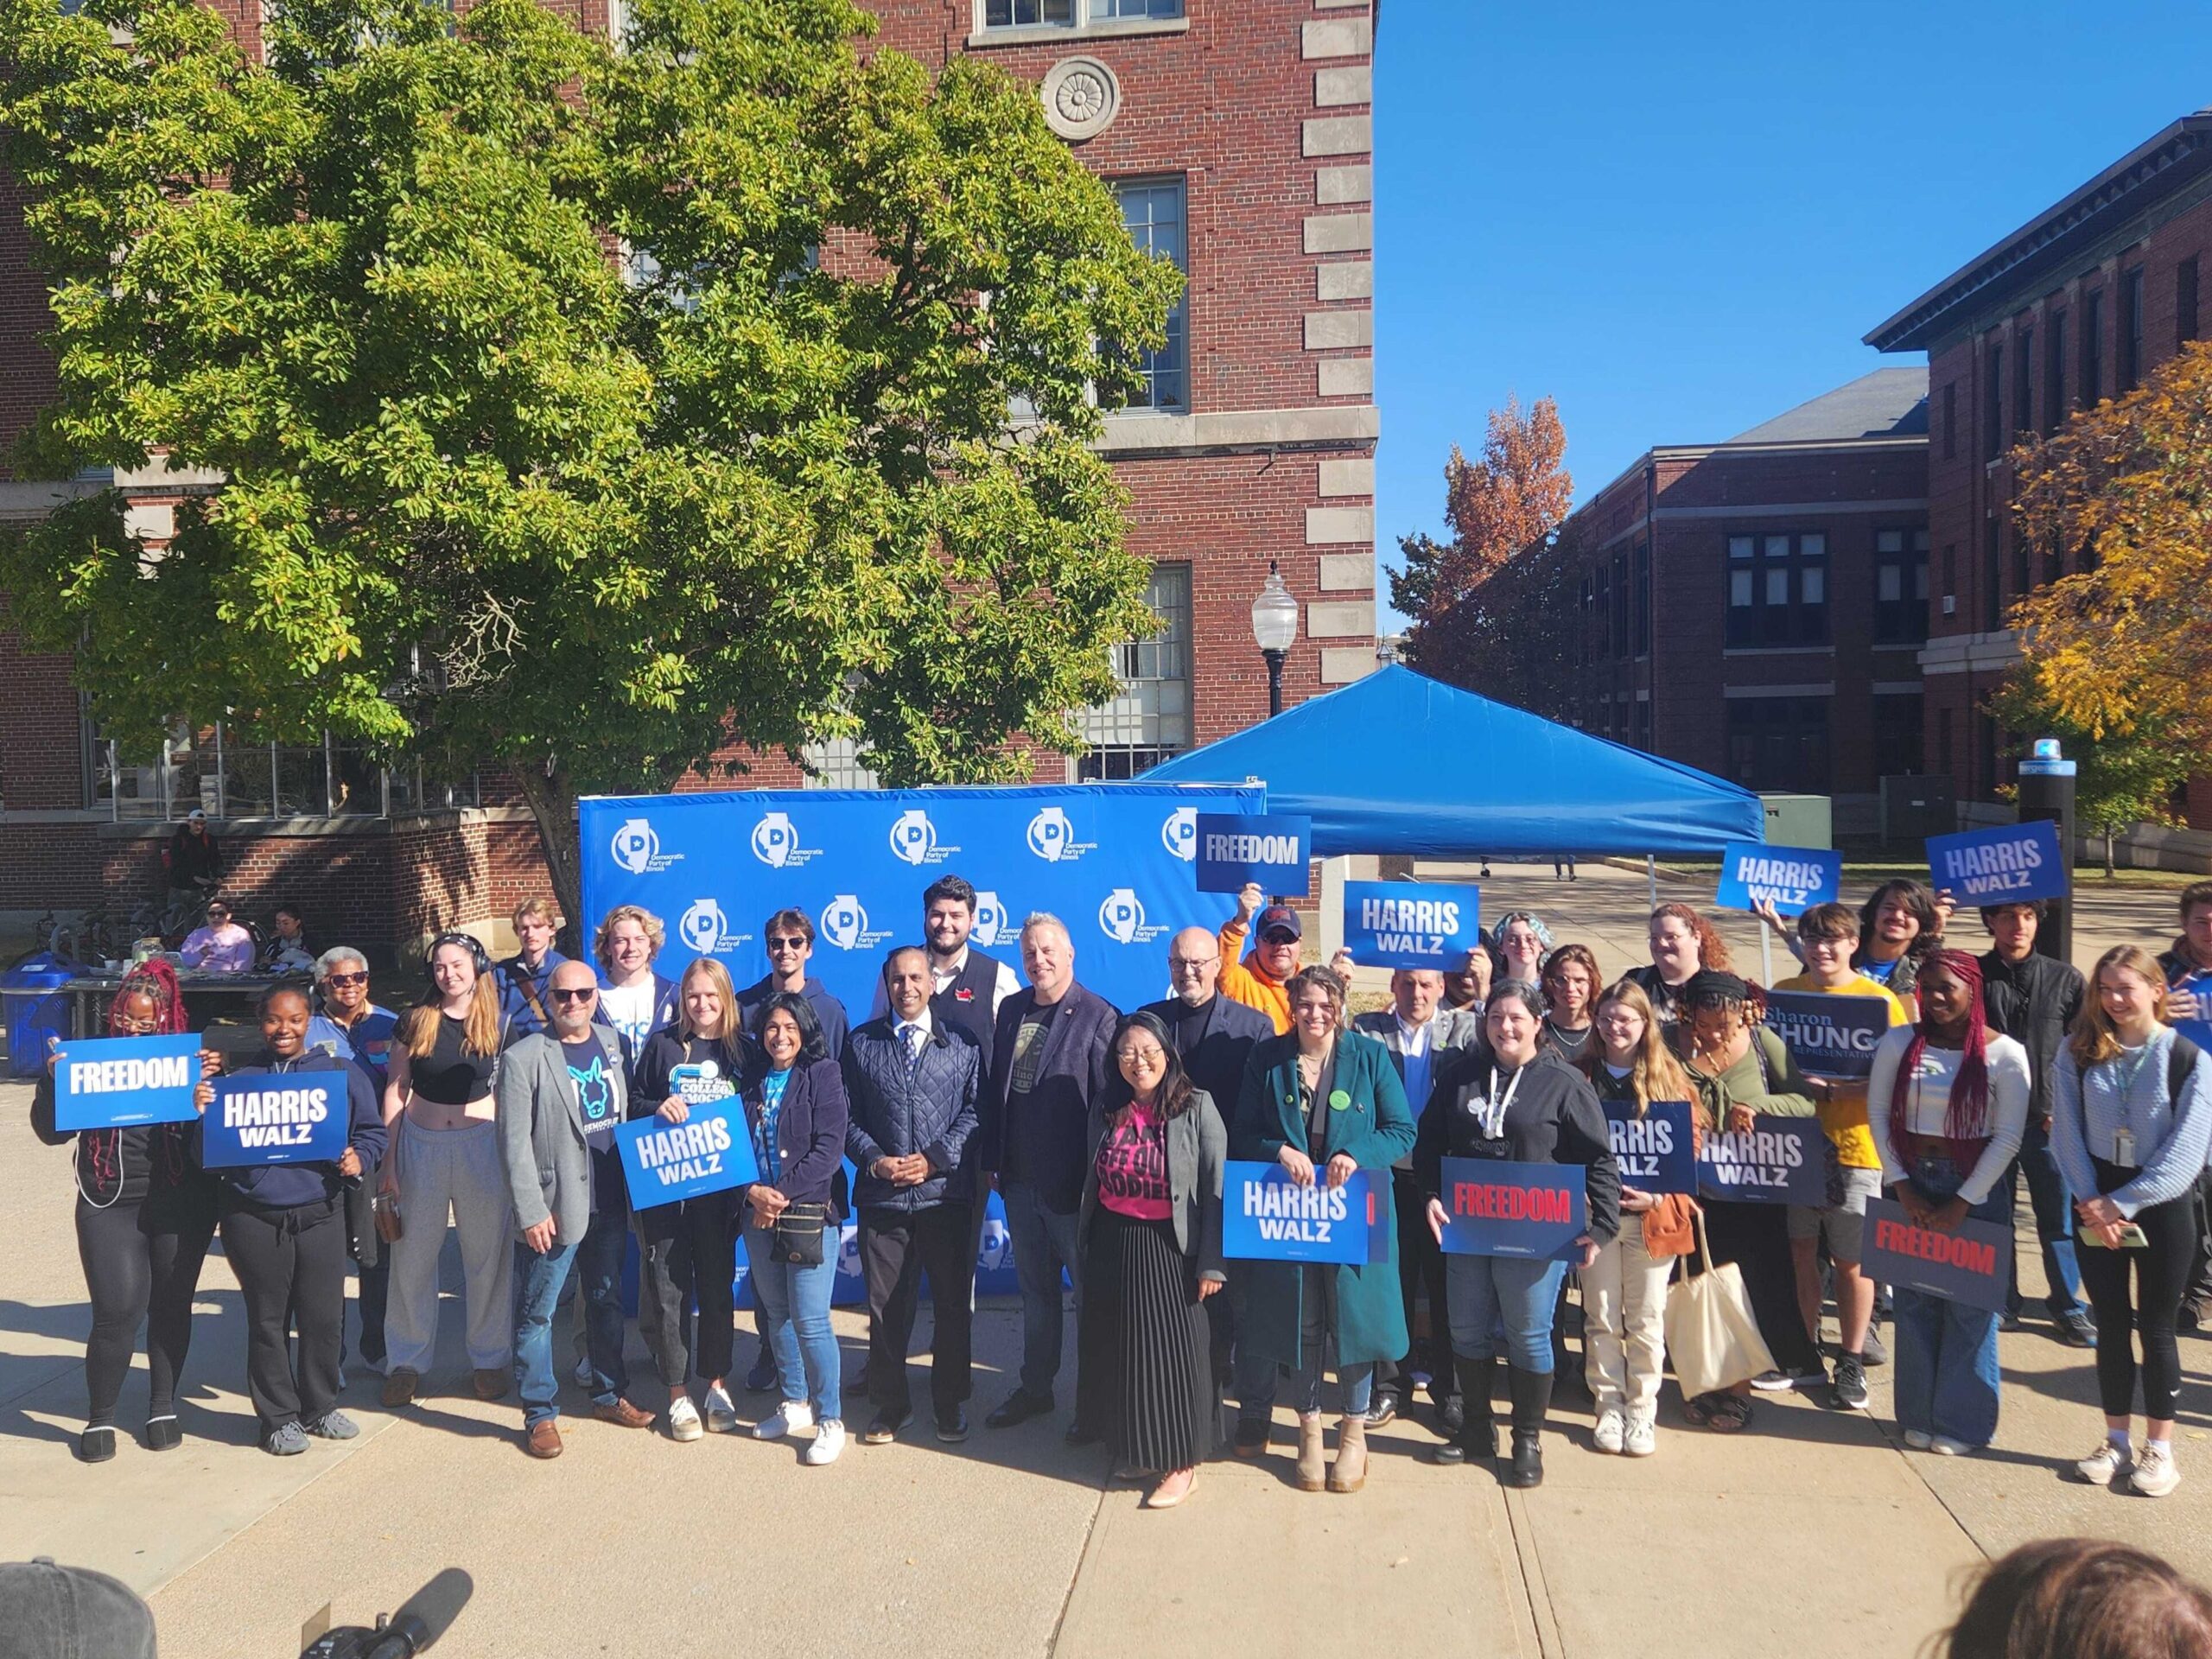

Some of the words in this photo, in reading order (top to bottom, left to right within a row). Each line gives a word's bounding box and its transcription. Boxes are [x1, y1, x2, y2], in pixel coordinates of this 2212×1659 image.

[1206, 834, 1299, 864] FREEDOM
[1944, 838, 2043, 880] HARRIS
[1737, 856, 1824, 891] HARRIS
[1963, 871, 2032, 895] WALZ
[1748, 883, 1808, 906] WALZ
[1362, 898, 1459, 936] HARRIS
[1376, 932, 1444, 955] WALZ
[1766, 1007, 1833, 1027] Sharon
[70, 1056, 188, 1095] FREEDOM
[224, 1088, 327, 1128] HARRIS
[239, 1124, 311, 1148] WALZ
[635, 1116, 731, 1169] HARRIS
[1609, 1120, 1674, 1154] RRIS
[1700, 1130, 1803, 1167] HARRIS
[657, 1153, 722, 1186] WALZ
[1134, 1147, 1162, 1180] OU
[1616, 1156, 1660, 1176] ALZ
[1715, 1164, 1789, 1187] WALZ
[1097, 1166, 1171, 1199] BODIE
[1243, 1180, 1347, 1222] HARRIS
[1453, 1182, 1571, 1224] FREEDOM
[1258, 1218, 1332, 1243] WALZ
[1875, 1218, 1996, 1277] FREEDOM
